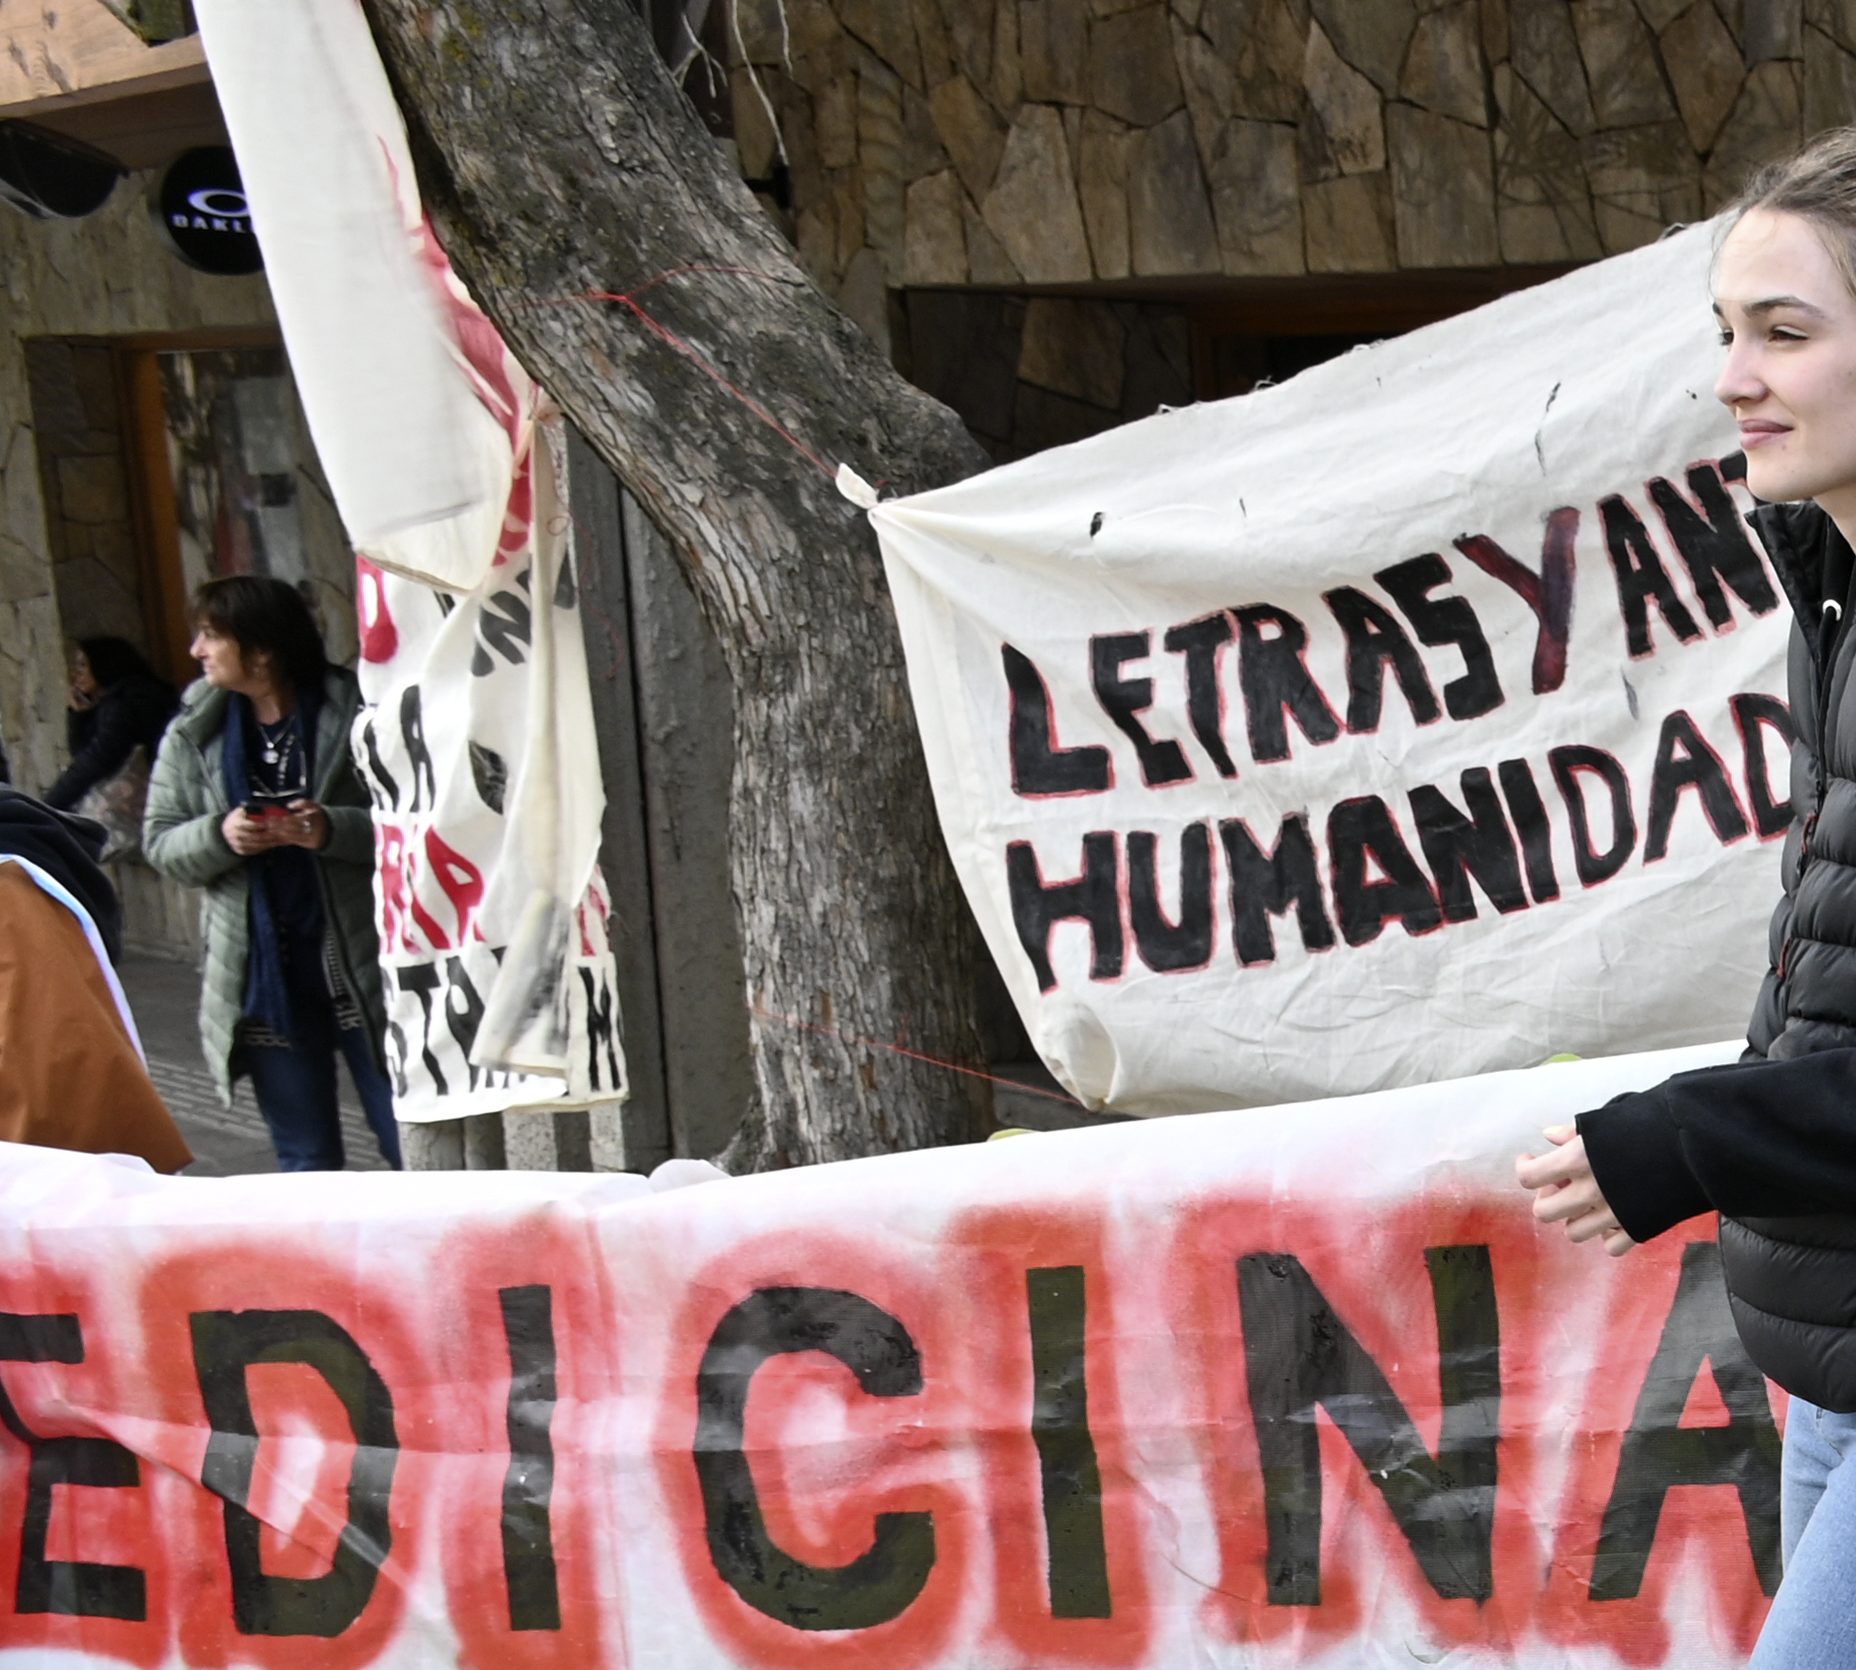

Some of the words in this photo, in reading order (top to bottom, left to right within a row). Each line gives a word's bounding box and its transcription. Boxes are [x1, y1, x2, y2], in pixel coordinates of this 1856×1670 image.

[1000, 551, 1504, 798] LETRAS
[1452, 505, 1582, 697] Y
[1005, 692, 1795, 995] HUMANIDAD
